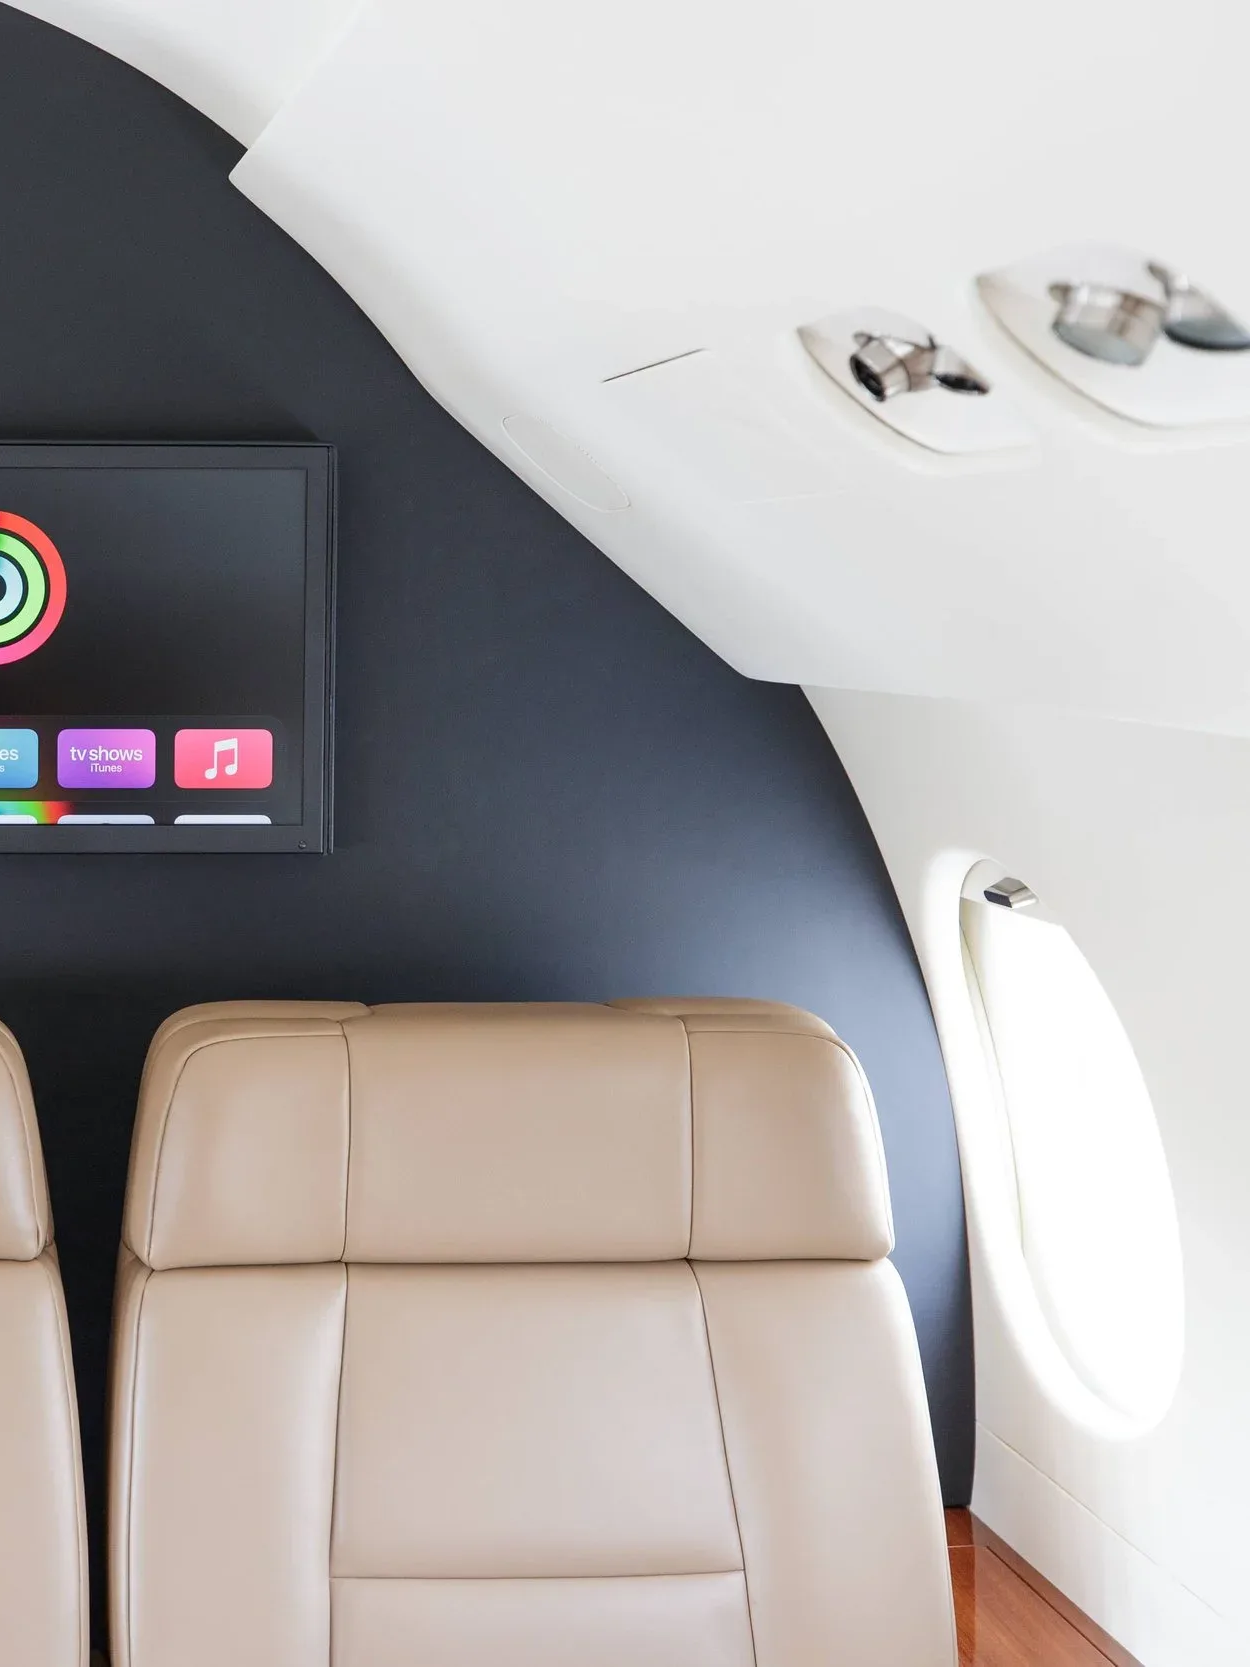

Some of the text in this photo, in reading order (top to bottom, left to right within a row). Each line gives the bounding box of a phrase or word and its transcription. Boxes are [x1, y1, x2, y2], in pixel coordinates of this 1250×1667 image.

[69, 745, 143, 761] tv shows
[90, 762, 123, 773] iTunes
